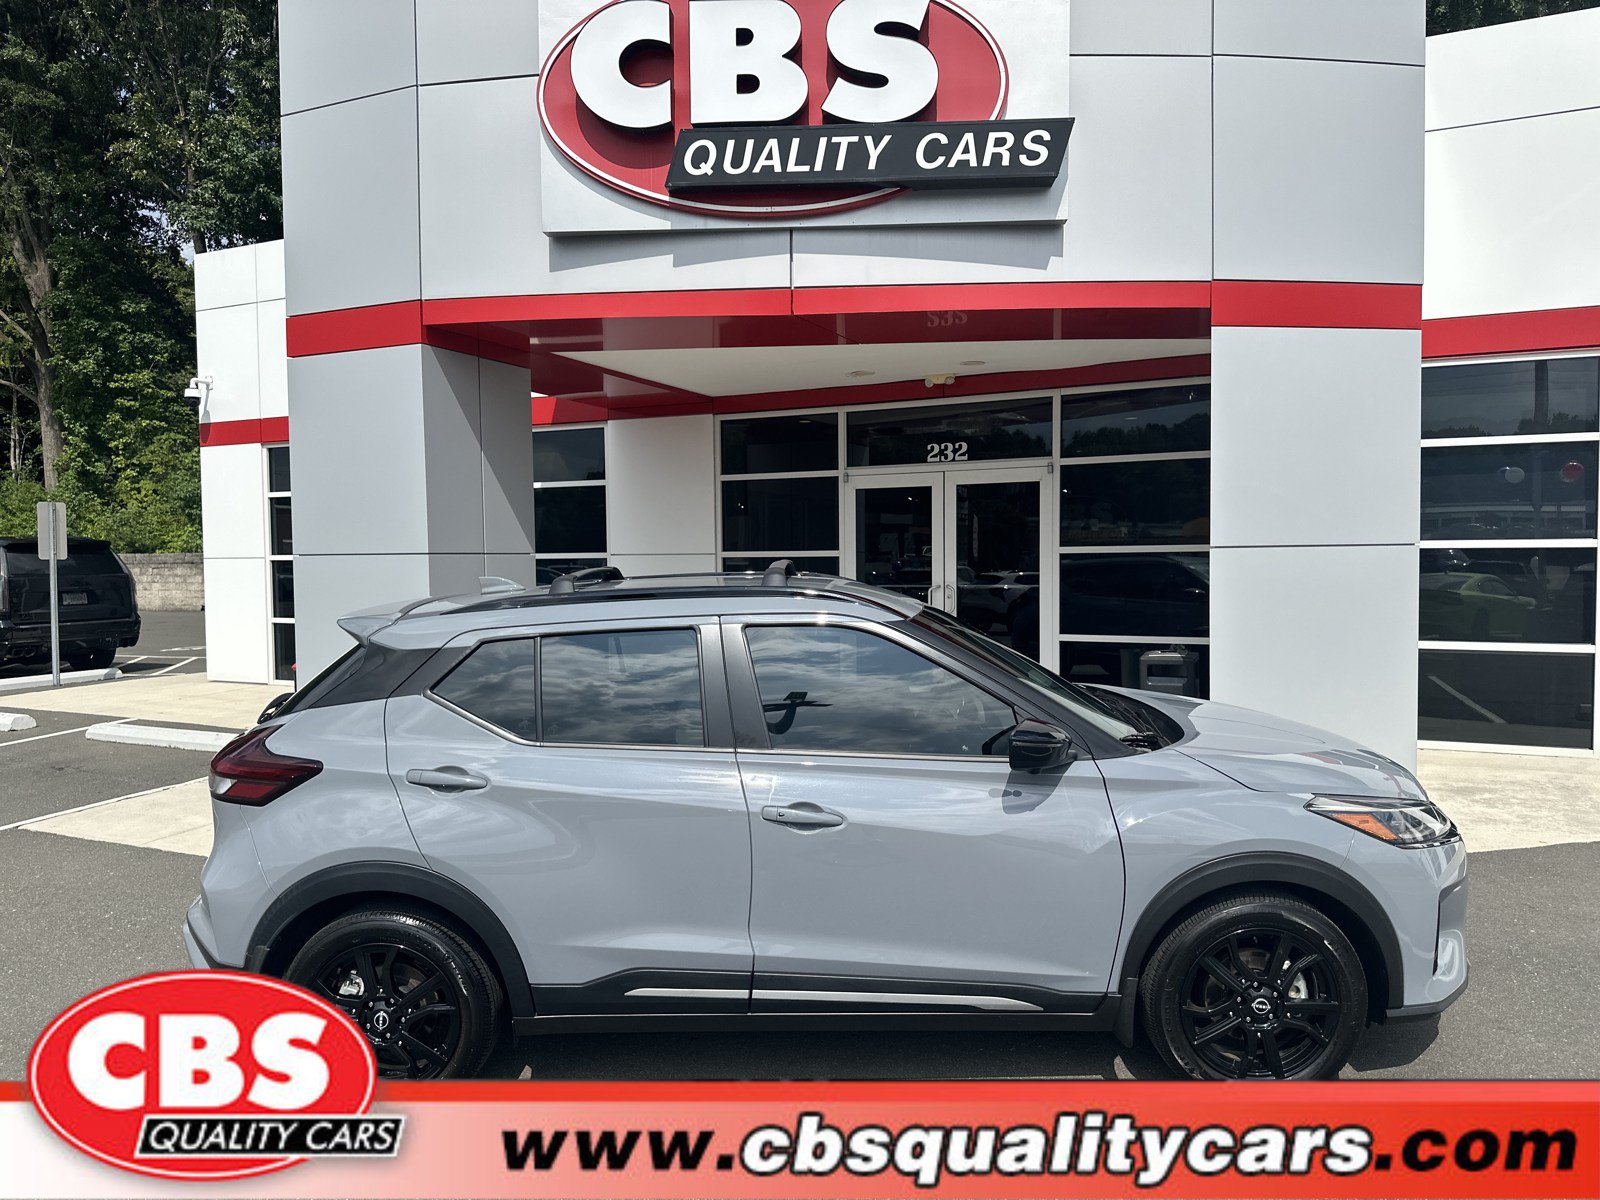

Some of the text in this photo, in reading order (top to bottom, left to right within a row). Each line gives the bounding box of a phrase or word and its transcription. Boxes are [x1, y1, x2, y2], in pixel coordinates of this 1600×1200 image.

[570, 0, 939, 128] CBS
[683, 129, 1051, 177] QUALITY CARS
[926, 441, 969, 463] 232
